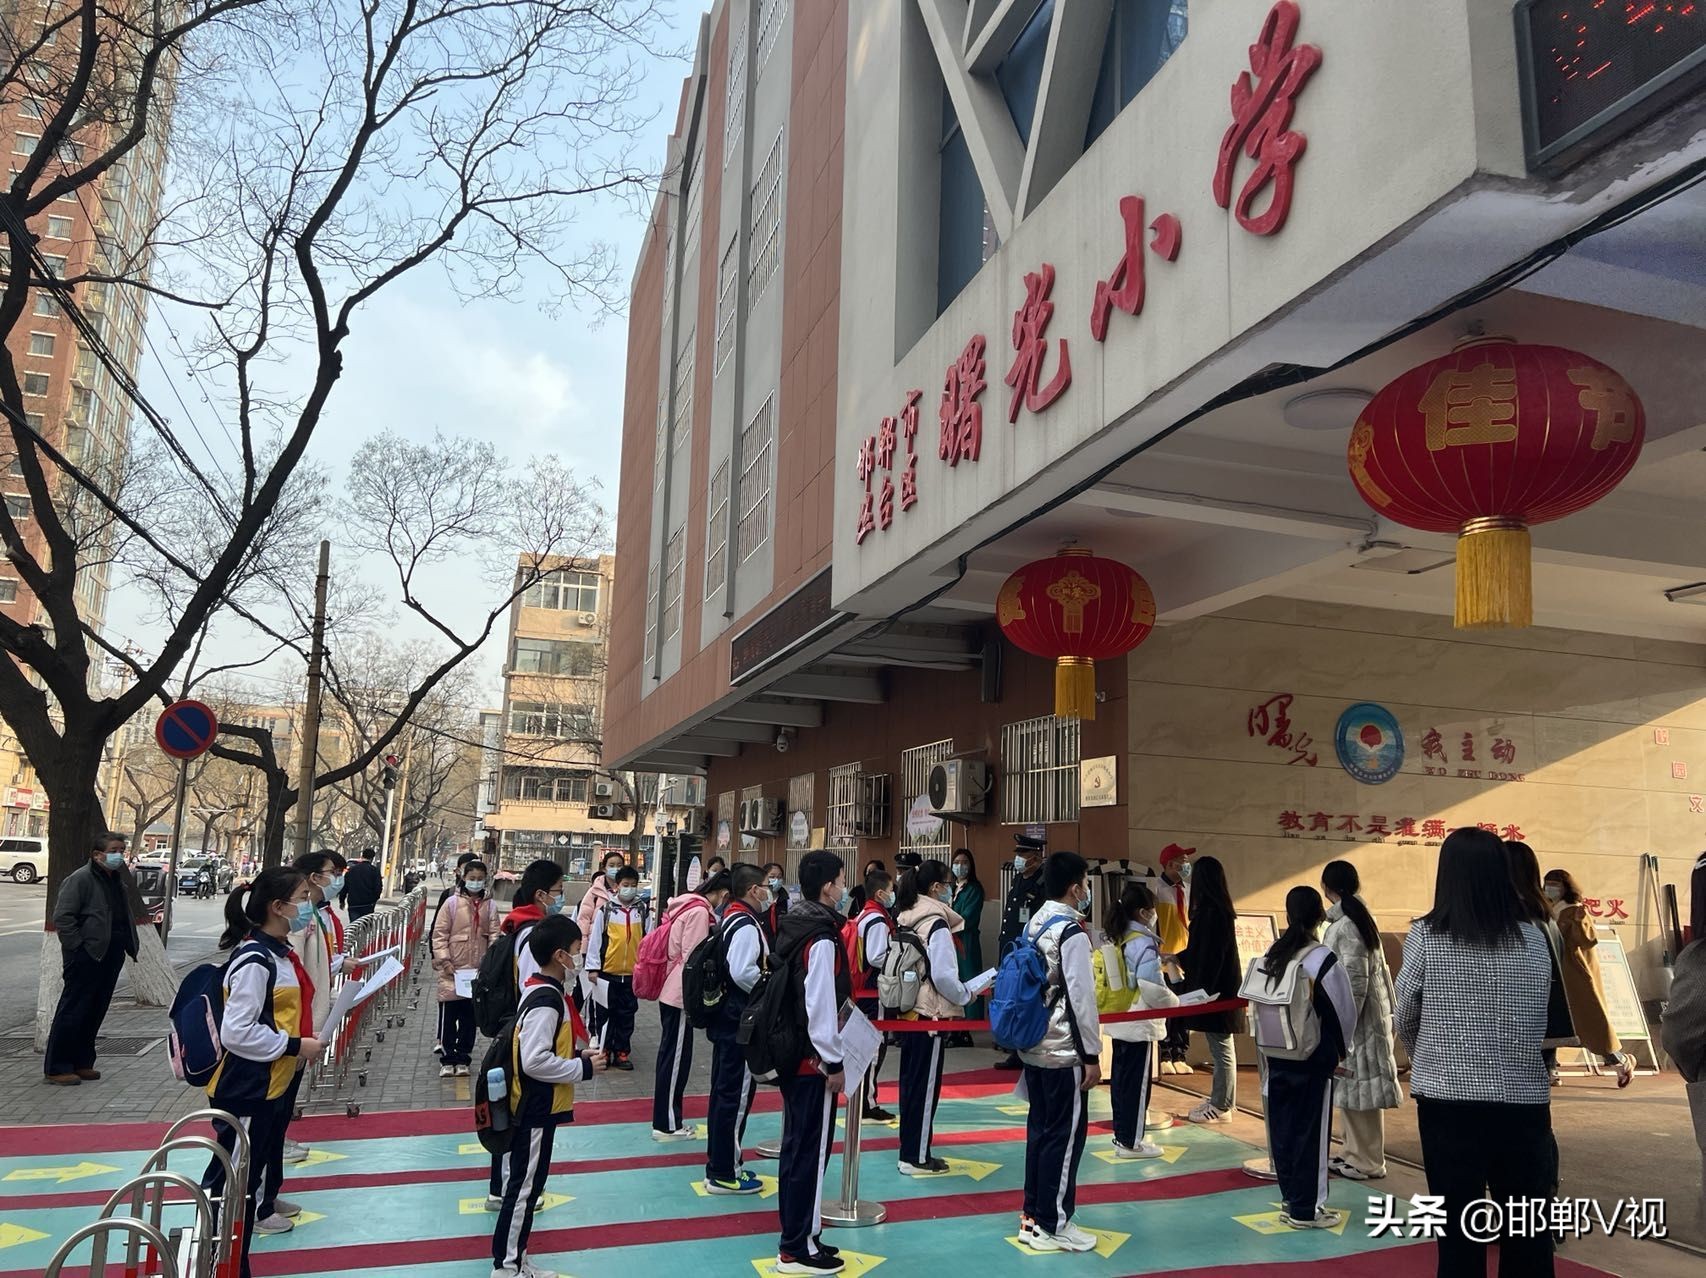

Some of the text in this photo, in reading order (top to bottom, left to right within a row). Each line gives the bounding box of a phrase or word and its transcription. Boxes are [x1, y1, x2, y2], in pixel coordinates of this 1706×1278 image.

[938, 0, 1323, 467] 曙光小学
[1421, 727, 1517, 765] 我主动
